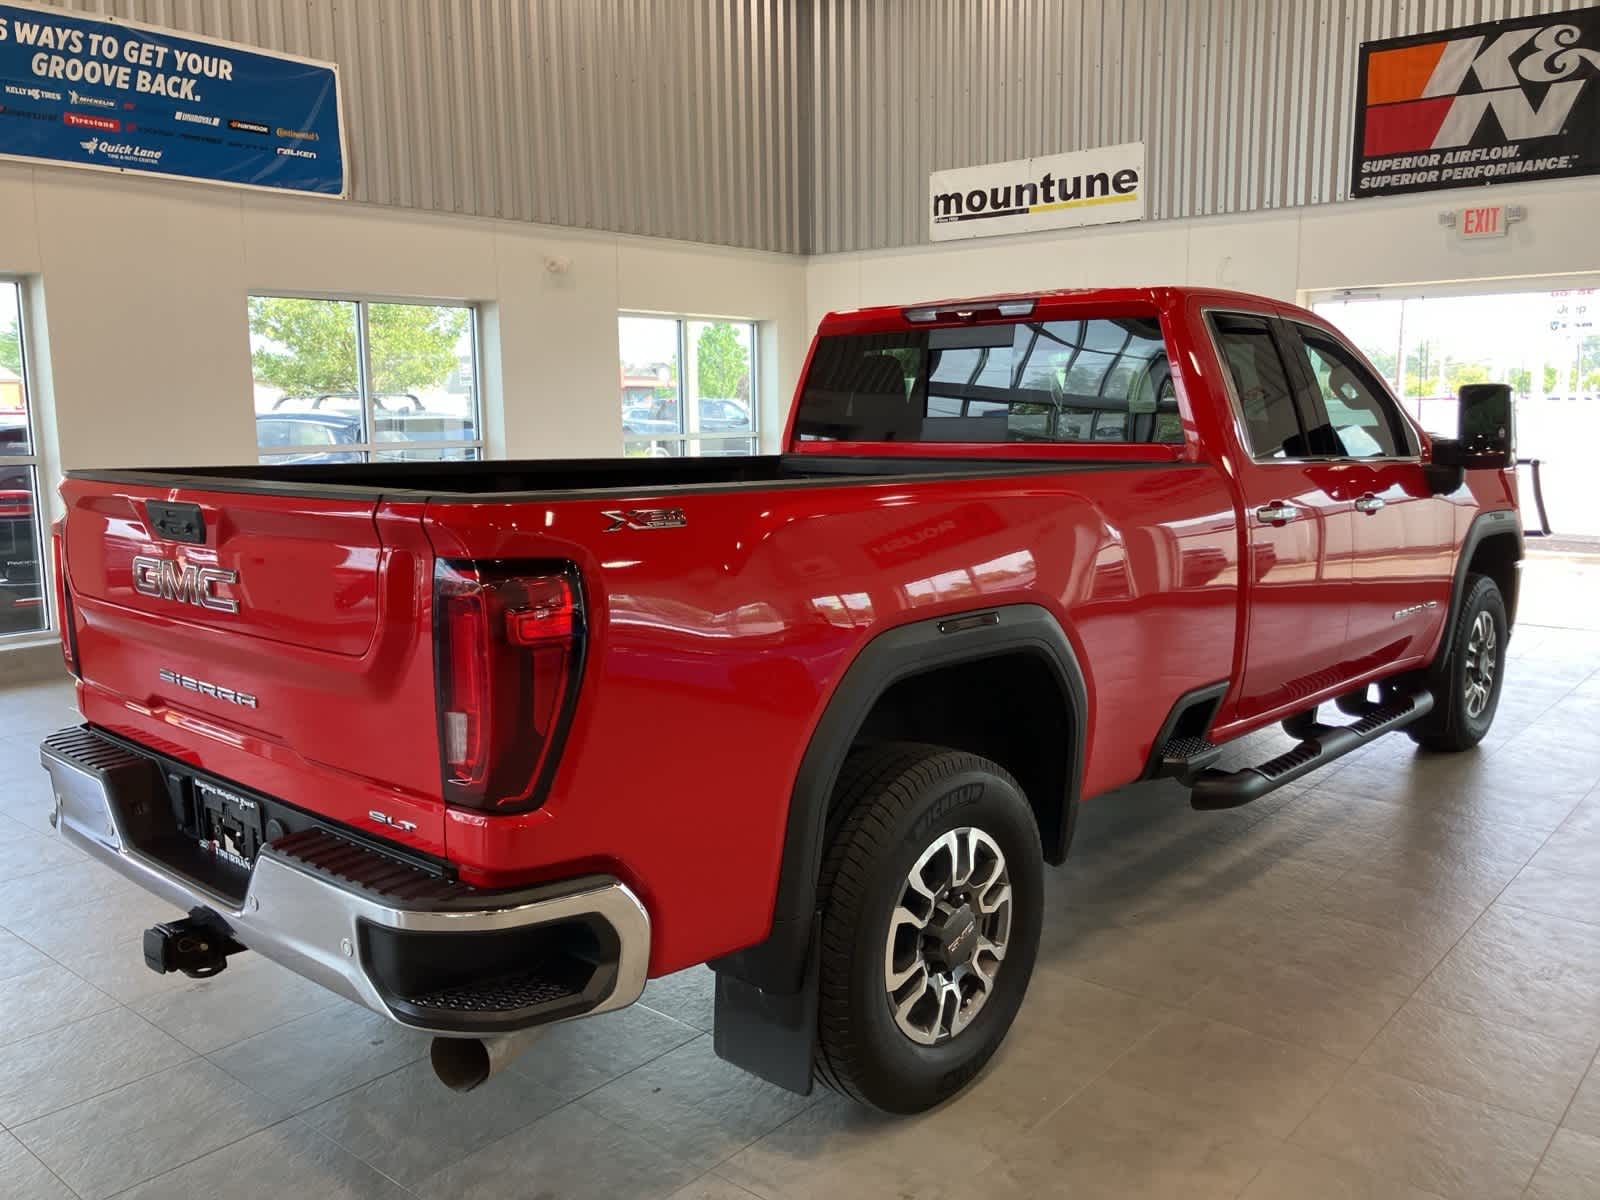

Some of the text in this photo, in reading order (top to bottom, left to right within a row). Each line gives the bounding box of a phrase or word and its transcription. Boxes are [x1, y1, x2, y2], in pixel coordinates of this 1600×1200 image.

[14, 21, 84, 53] WAYS
[88, 33, 119, 60] TO
[123, 40, 169, 68] GET
[174, 49, 233, 81] YOUR
[5, 85, 27, 95] KELLY
[31, 52, 201, 102] GROOVE BACK.
[99, 141, 162, 159] Quick Lane
[1361, 145, 1521, 174] SUPERIOR AIRFLOW.
[933, 168, 1139, 217] mountune
[1359, 170, 1438, 190] SUPERIOR
[1463, 207, 1500, 235] EXIT
[132, 555, 240, 614] GMC
[159, 667, 259, 709] SIERRA
[368, 810, 417, 832] SLT
